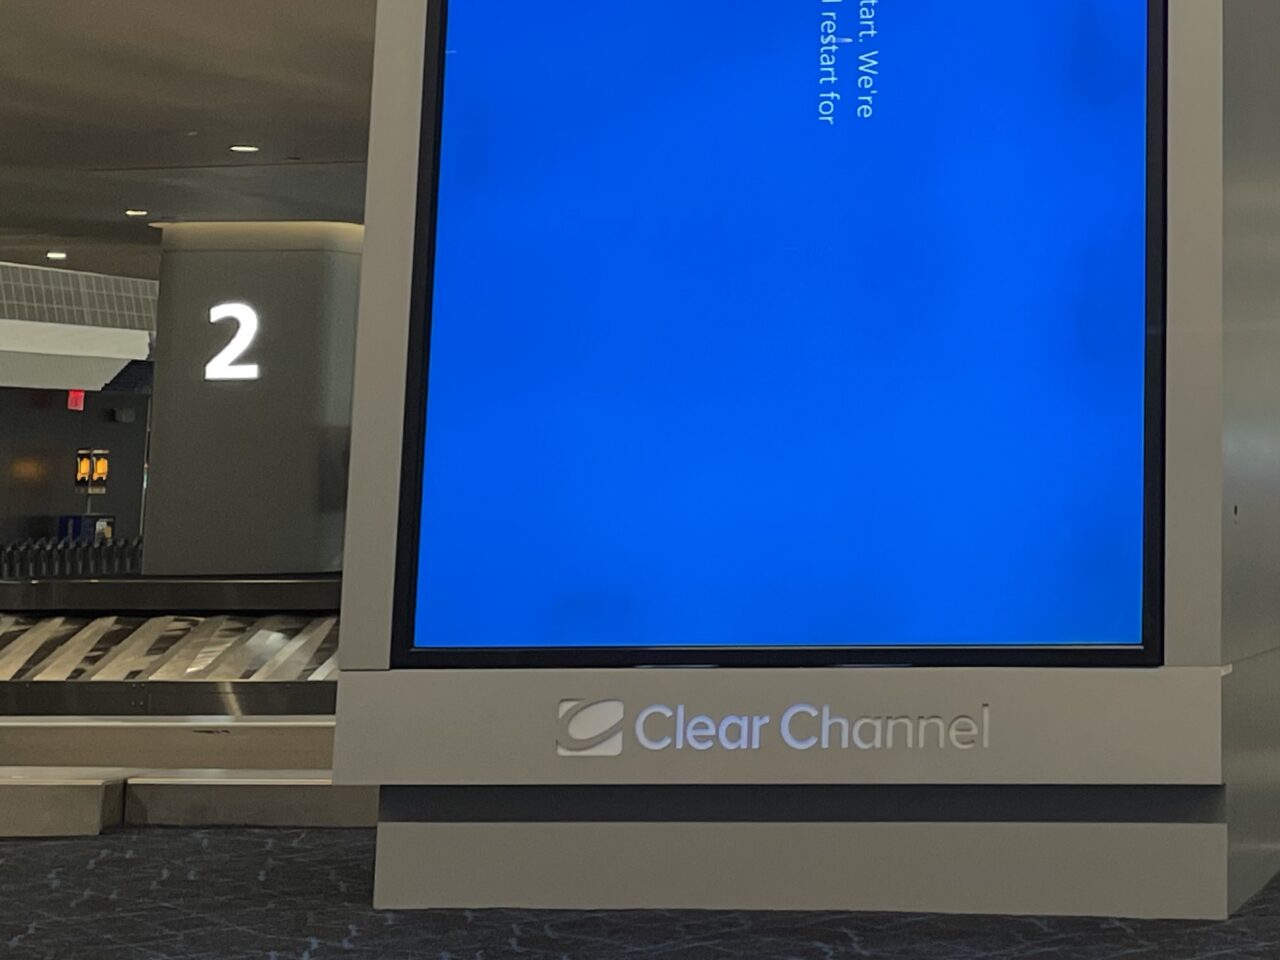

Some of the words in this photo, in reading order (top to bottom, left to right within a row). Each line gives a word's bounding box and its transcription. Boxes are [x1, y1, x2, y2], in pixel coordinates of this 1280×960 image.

[820, 11, 841, 85] restart
[818, 91, 840, 125] for
[856, 50, 878, 118] We're
[204, 302, 259, 381] 2
[635, 703, 770, 750] Clear
[780, 703, 989, 750] Channel
